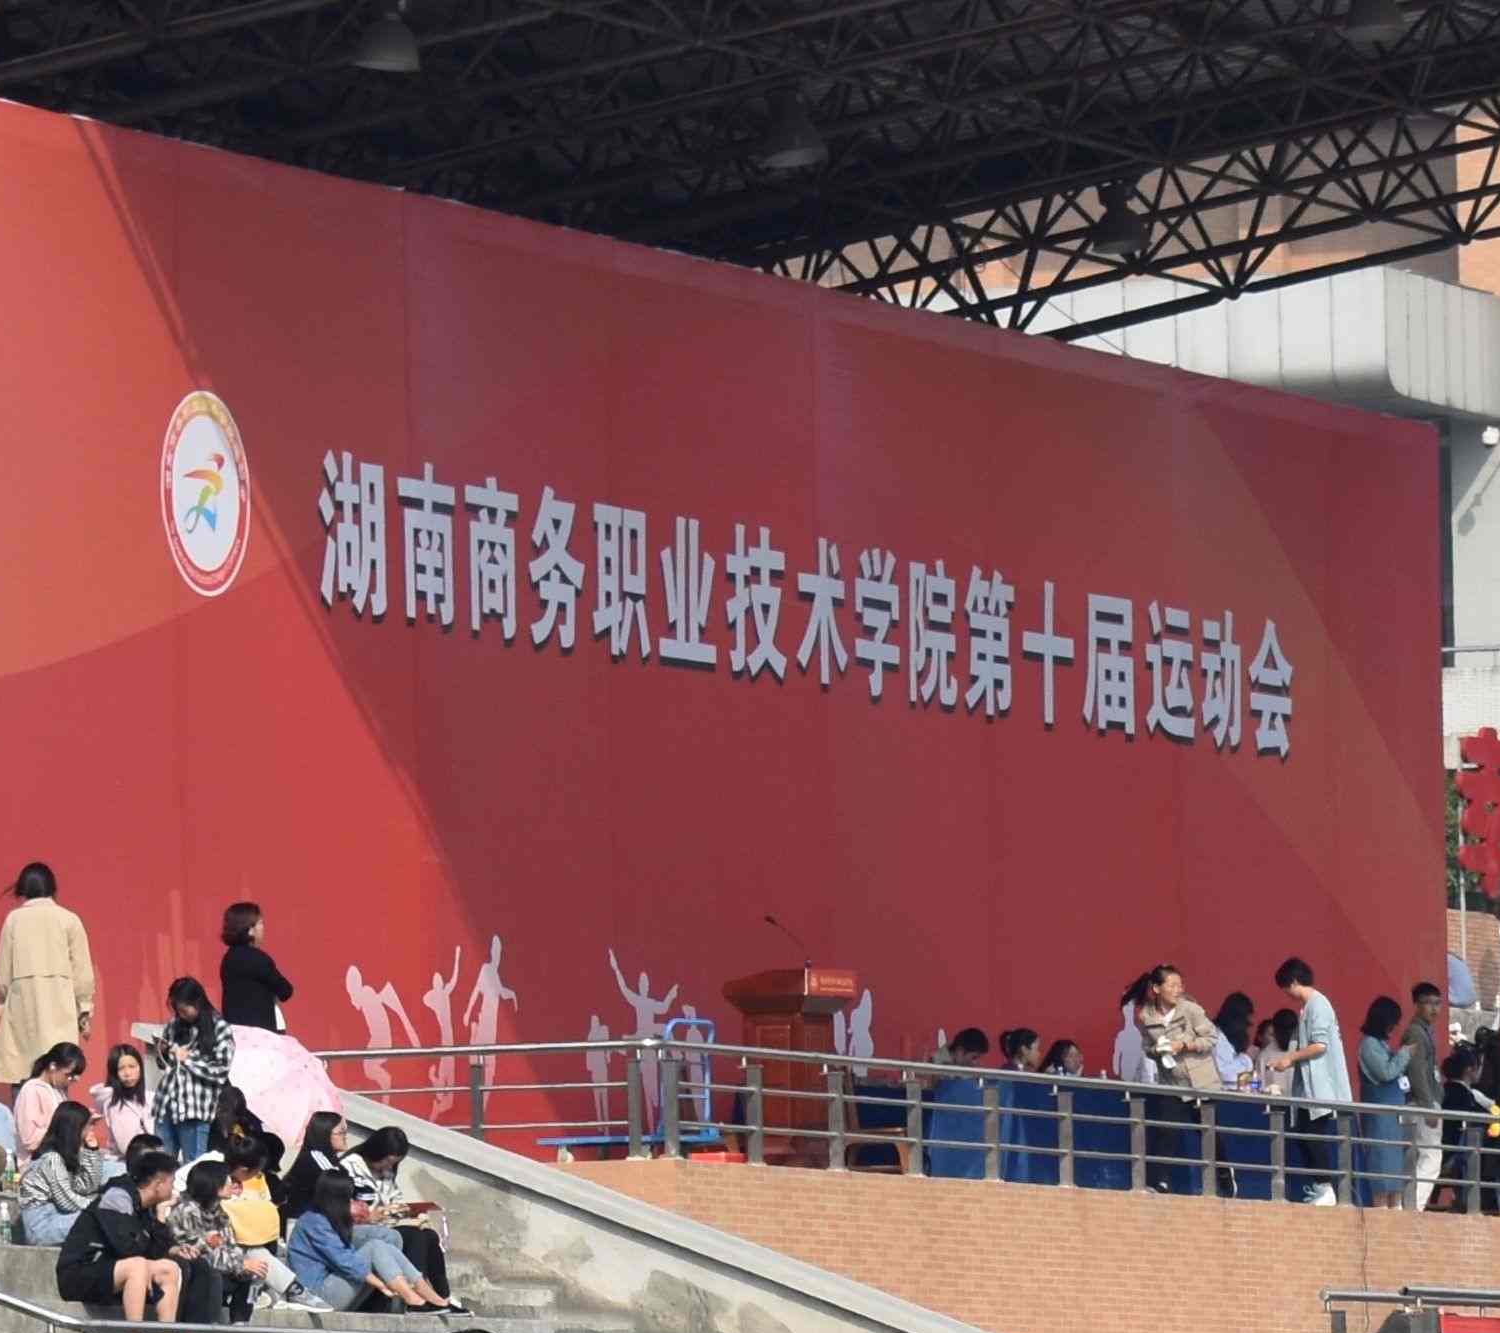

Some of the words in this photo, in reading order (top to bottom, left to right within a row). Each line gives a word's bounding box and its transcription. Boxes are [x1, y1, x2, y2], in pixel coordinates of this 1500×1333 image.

[318, 449, 1294, 759] 湖南商务职业技术学院第十届运动会
